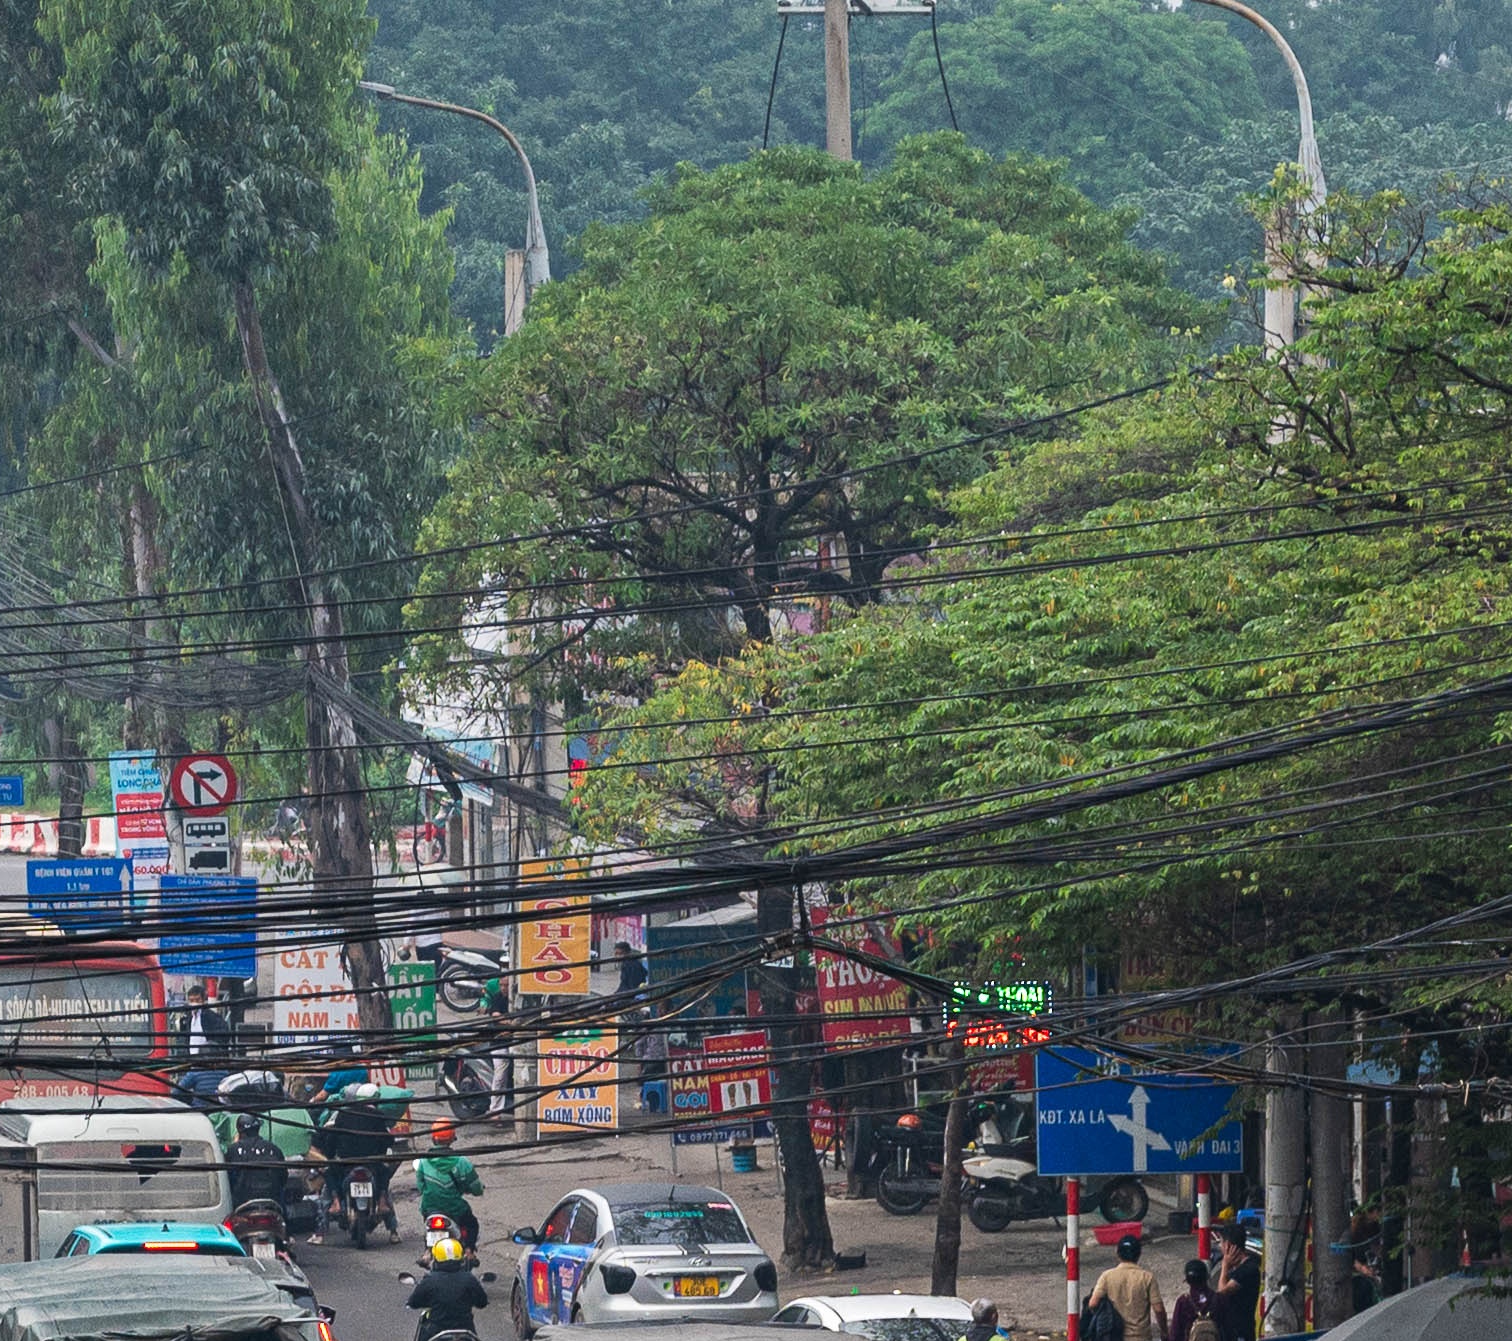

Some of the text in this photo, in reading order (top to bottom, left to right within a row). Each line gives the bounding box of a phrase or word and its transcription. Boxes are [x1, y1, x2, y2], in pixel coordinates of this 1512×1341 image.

[288, 1012, 329, 1028] NAM
[1069, 1109, 1085, 1123] XA
[1089, 1109, 1105, 1123] LA
[1233, 1139, 1242, 1153] 3
